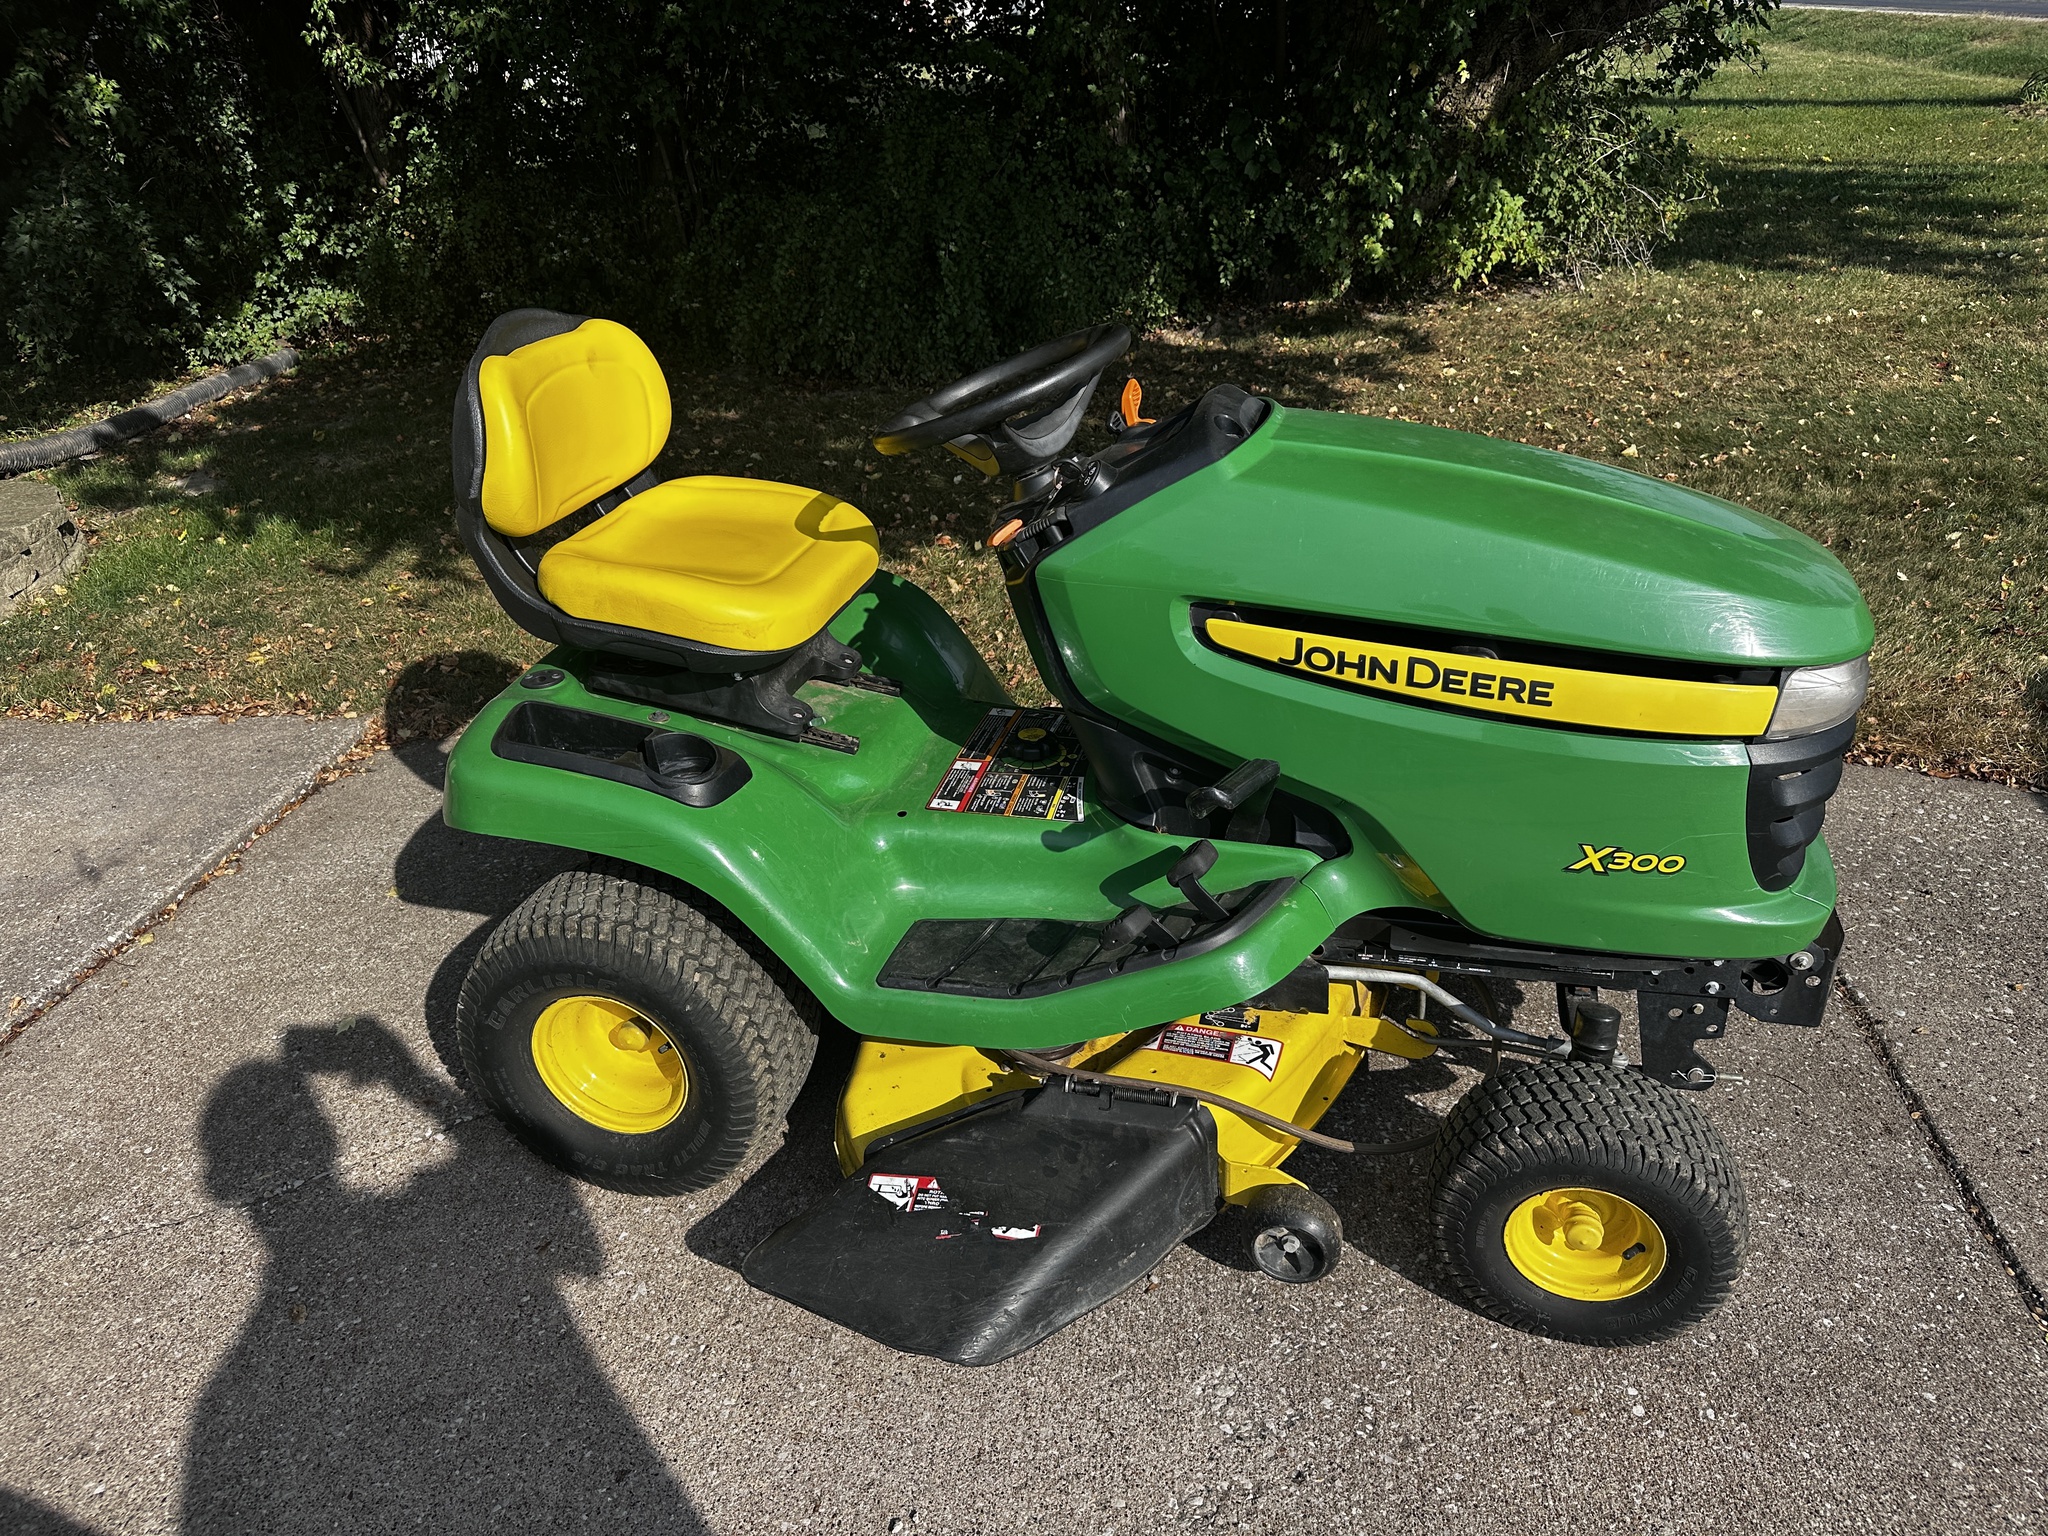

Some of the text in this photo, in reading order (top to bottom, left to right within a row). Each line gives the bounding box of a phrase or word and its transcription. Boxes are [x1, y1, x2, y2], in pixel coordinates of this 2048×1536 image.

[1277, 637, 1555, 707] JOHN DEERE
[1563, 844, 1686, 875] X300
[487, 972, 618, 1030] CARLISLE
[1604, 1265, 1698, 1329] CARLISLE
